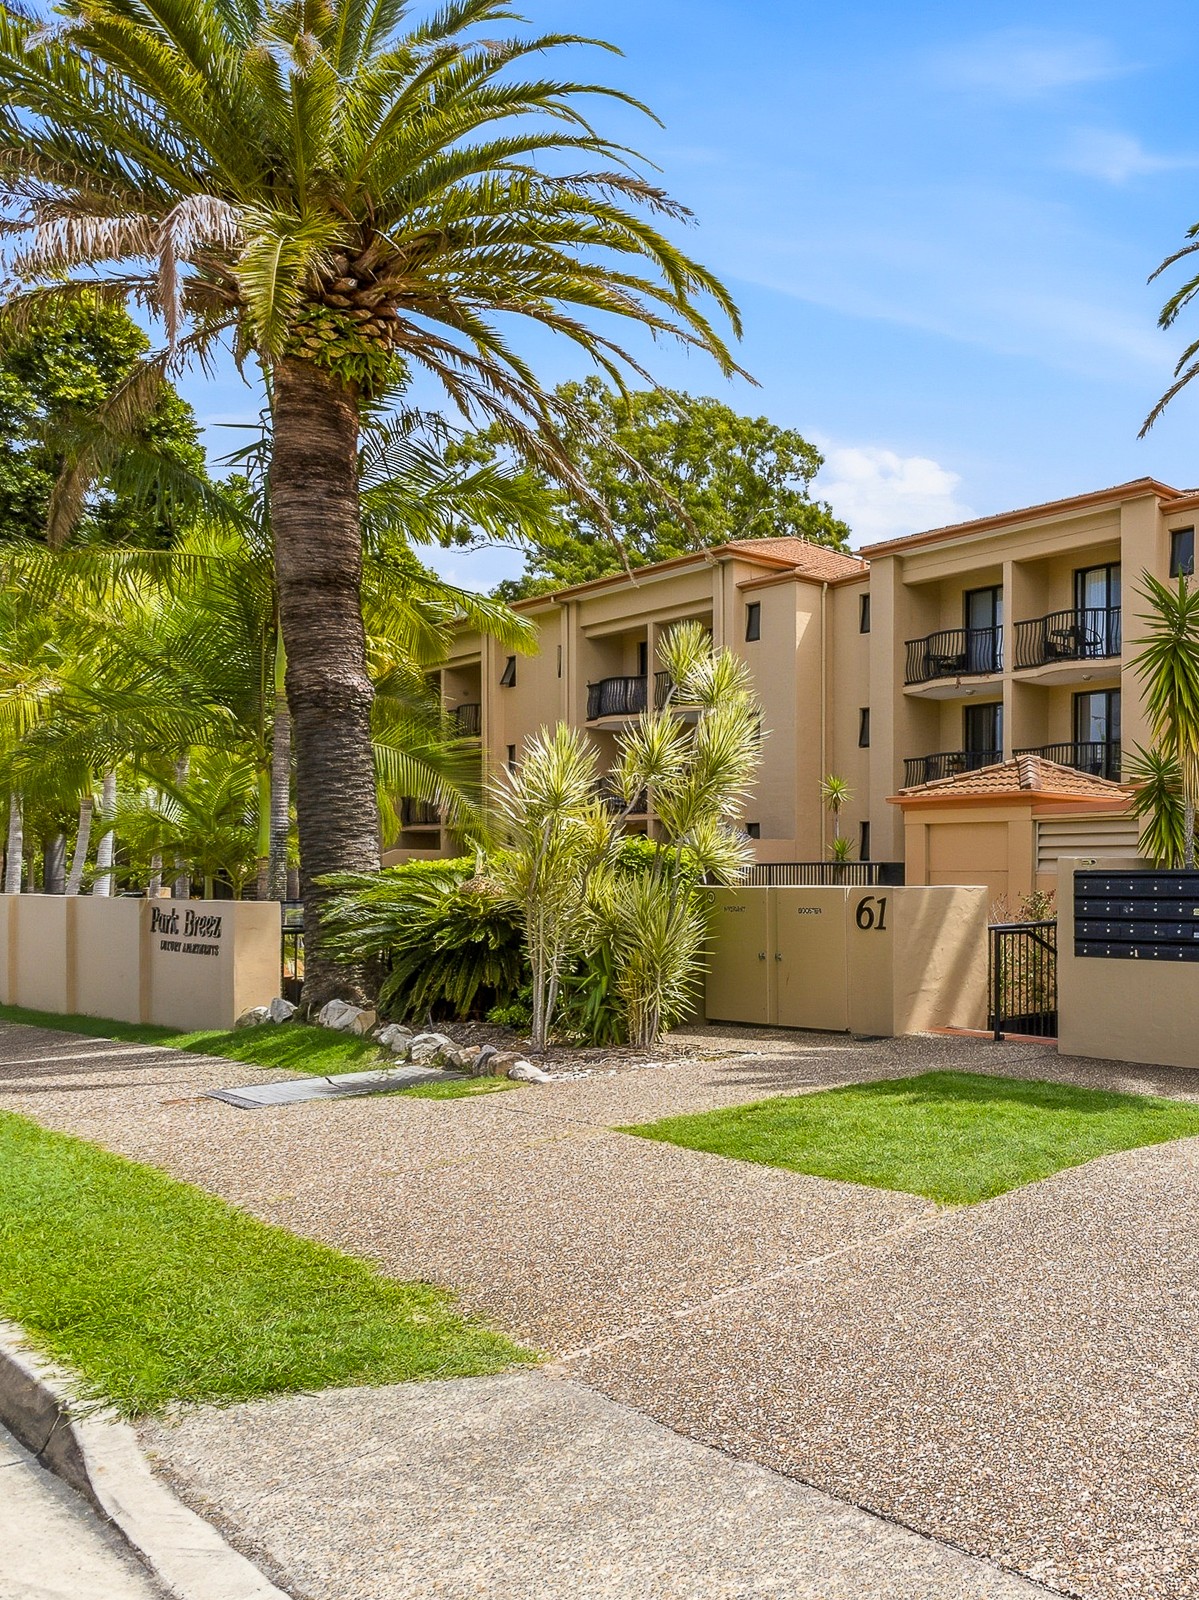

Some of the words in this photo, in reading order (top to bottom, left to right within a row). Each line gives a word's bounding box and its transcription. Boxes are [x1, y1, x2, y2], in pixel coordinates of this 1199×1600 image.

[150, 907, 179, 934] Park
[183, 909, 222, 938] Breez
[856, 896, 887, 930] 61
